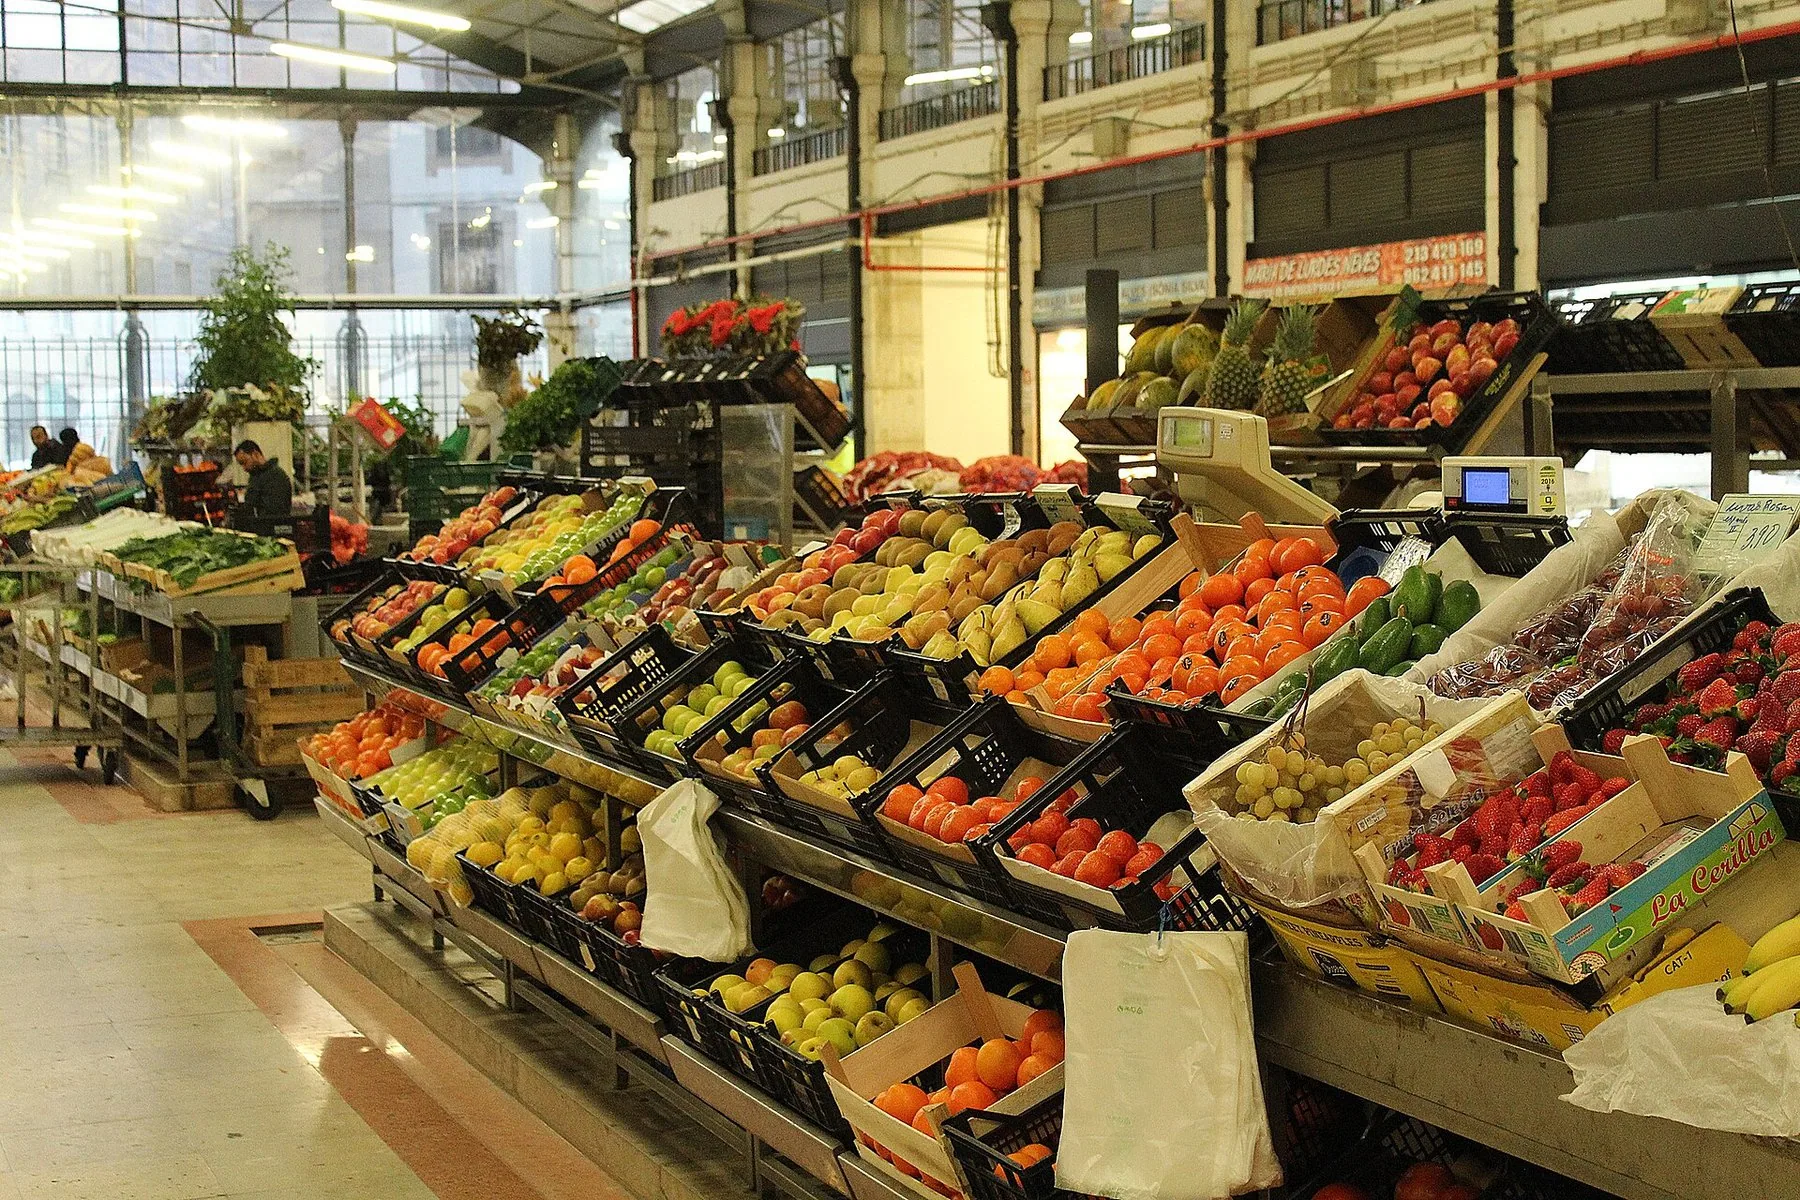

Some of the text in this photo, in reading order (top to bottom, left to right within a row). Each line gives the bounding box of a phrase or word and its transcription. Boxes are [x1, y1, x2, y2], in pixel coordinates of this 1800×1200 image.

[1279, 260, 1297, 281] DE
[1343, 249, 1382, 276] NEVES
[1651, 827, 1776, 928] La Cerilla
[1664, 950, 1693, 976] CAT-1
